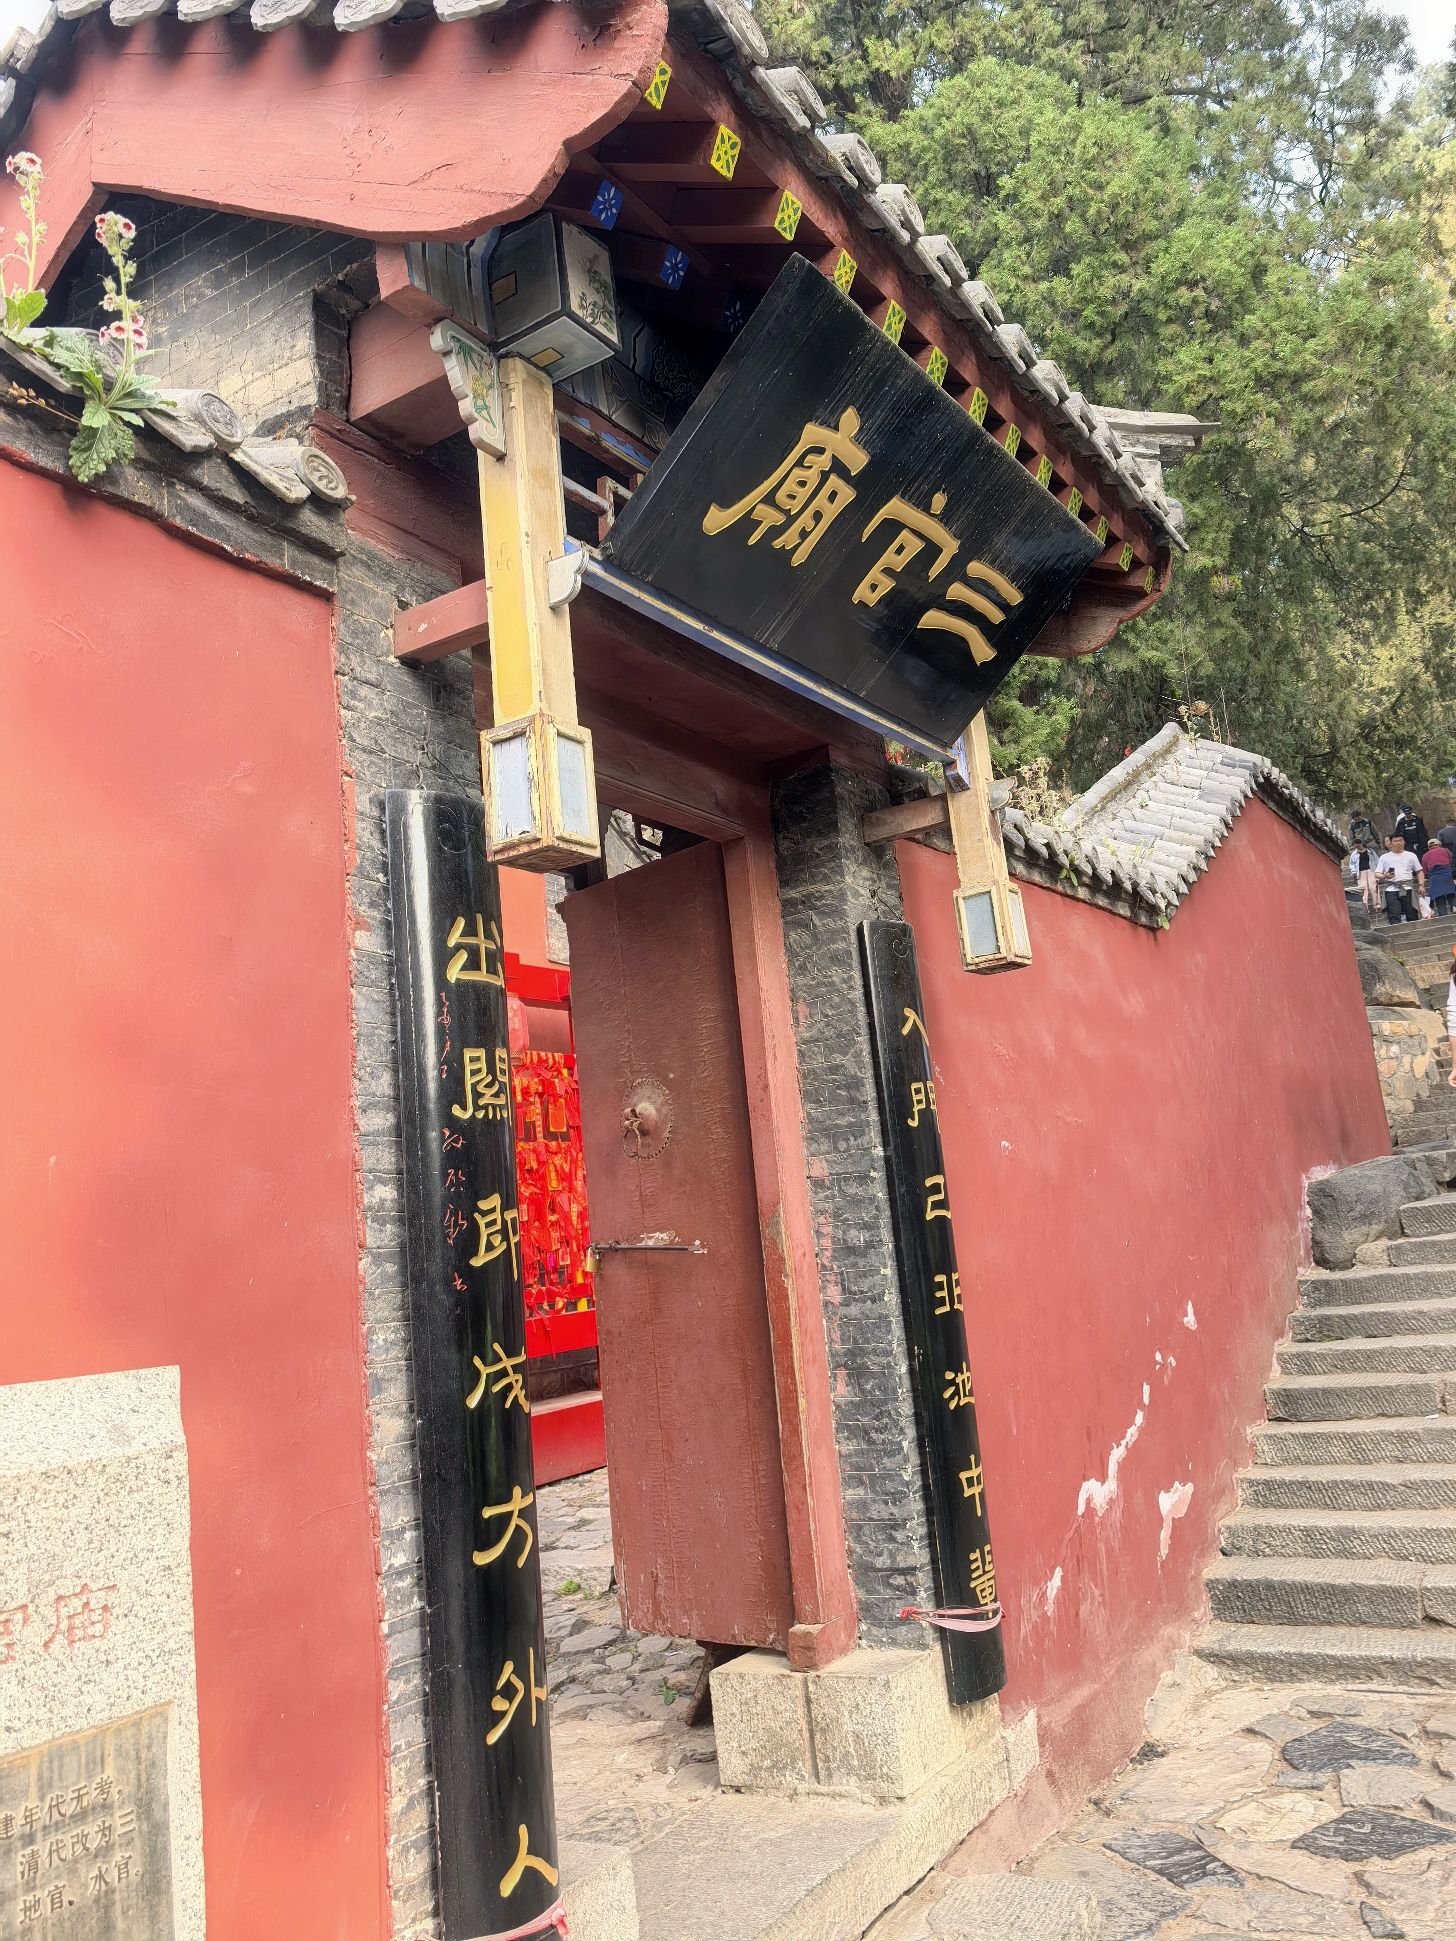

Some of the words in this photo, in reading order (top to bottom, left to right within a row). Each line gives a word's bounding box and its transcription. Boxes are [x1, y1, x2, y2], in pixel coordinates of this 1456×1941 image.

[19, 1808, 137, 1881] 清代改为三
